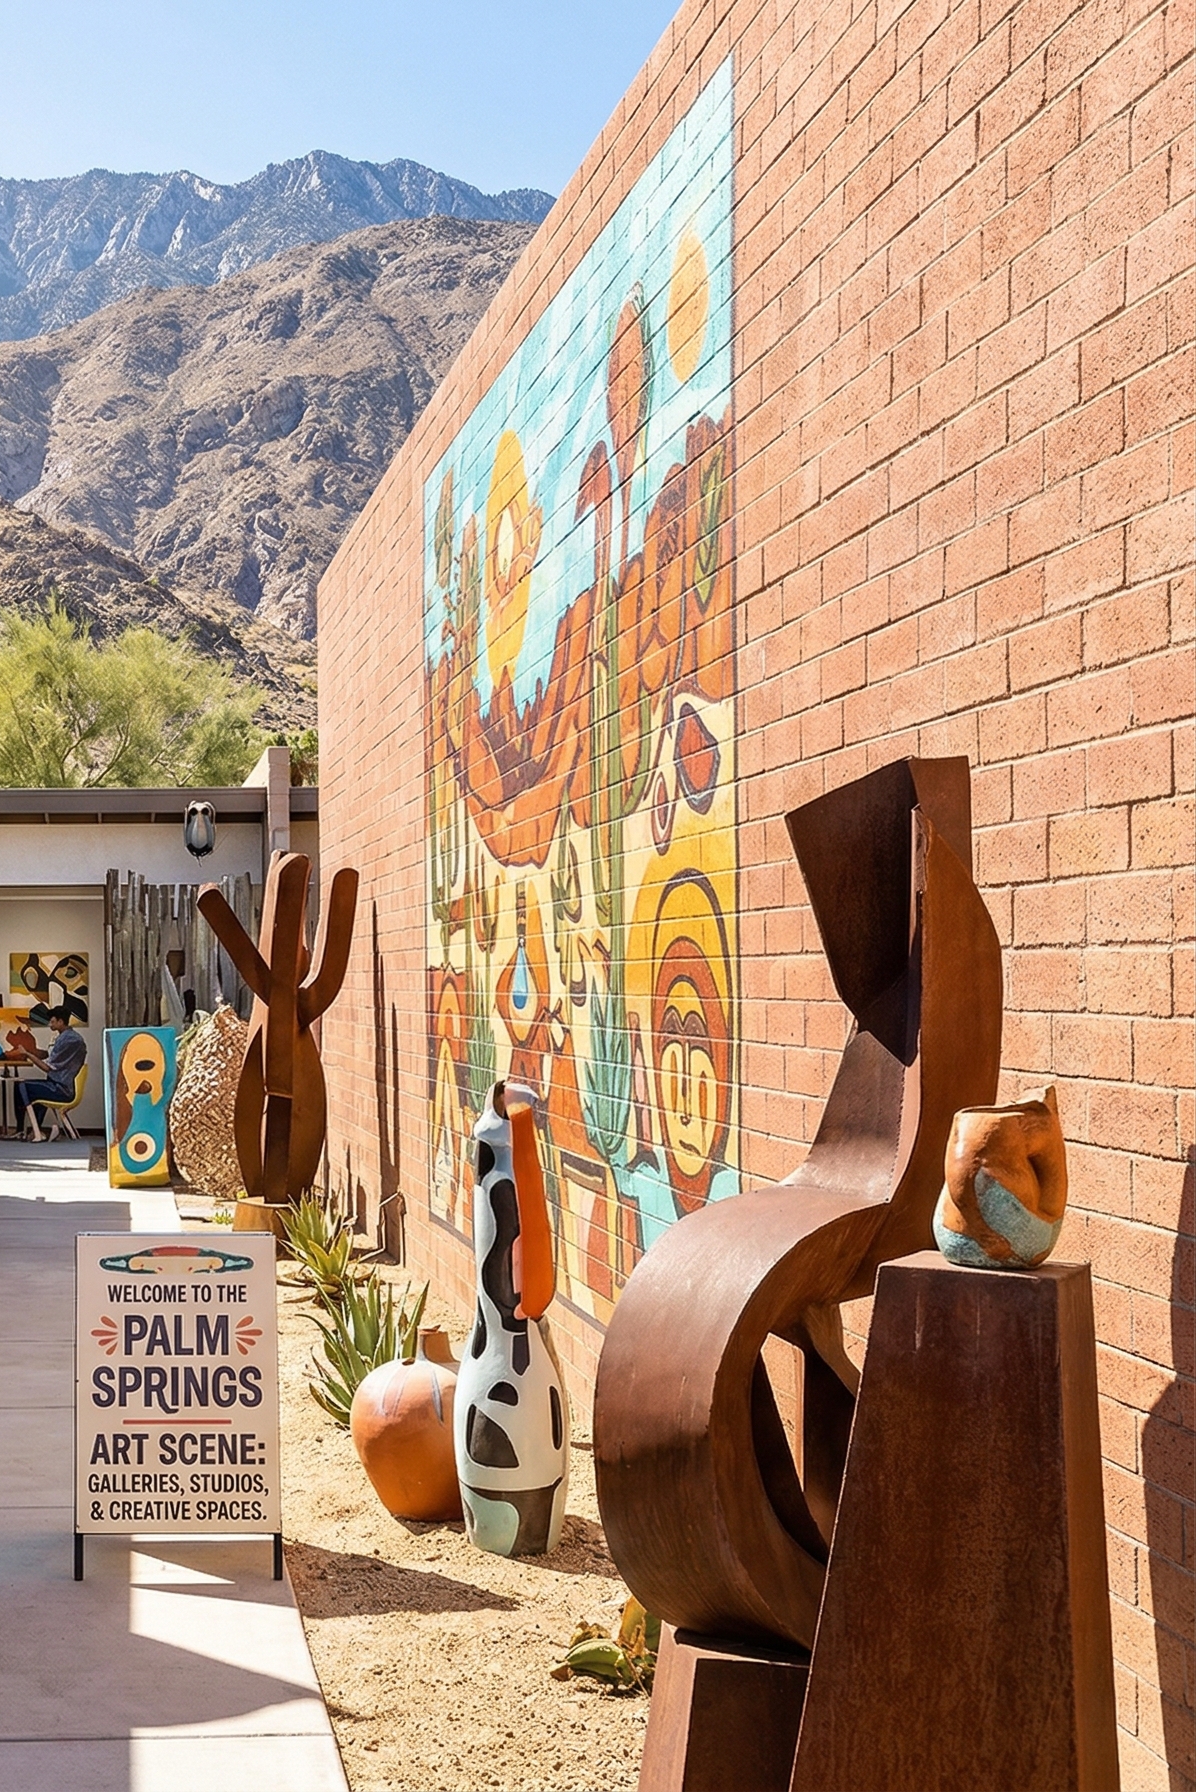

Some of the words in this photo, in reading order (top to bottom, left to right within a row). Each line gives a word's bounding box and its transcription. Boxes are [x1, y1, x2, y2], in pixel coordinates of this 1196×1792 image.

[107, 1284, 187, 1303] WELCOME
[190, 1284, 212, 1303] TO
[216, 1284, 247, 1303] THE
[124, 1314, 230, 1356] PALM
[91, 1365, 263, 1415] SPRINGS
[89, 1433, 150, 1465] ART
[158, 1432, 266, 1466] SCENE:
[88, 1473, 185, 1497] GALLERIES,
[189, 1473, 269, 1497] STUDIOS,
[90, 1500, 105, 1521] &
[109, 1500, 192, 1521] CREATIVE
[195, 1500, 267, 1521] SPACES.
